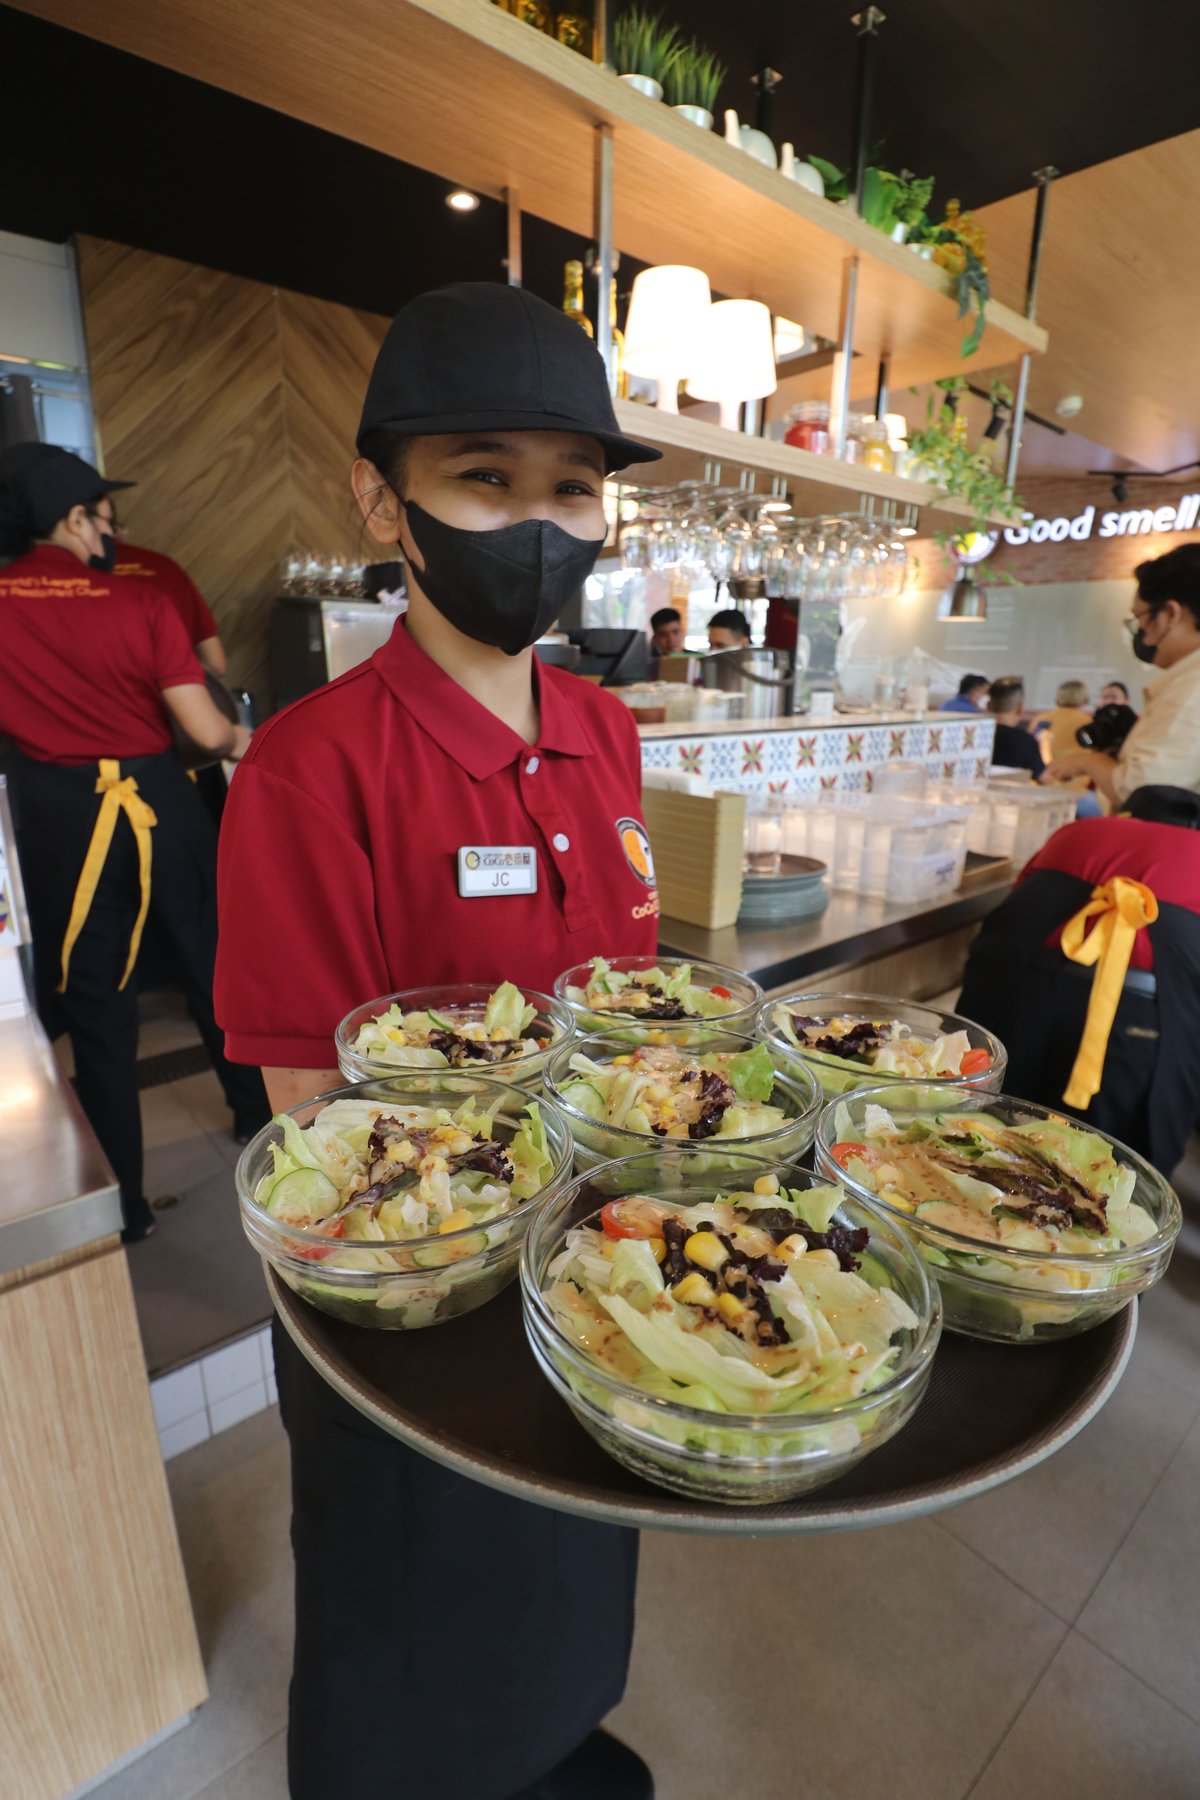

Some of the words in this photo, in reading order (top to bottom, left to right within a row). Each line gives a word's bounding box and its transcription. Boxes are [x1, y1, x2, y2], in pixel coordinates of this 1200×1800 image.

[1004, 505, 1096, 545] Good
[1099, 494, 1200, 538] smell
[492, 872, 510, 888] JC
